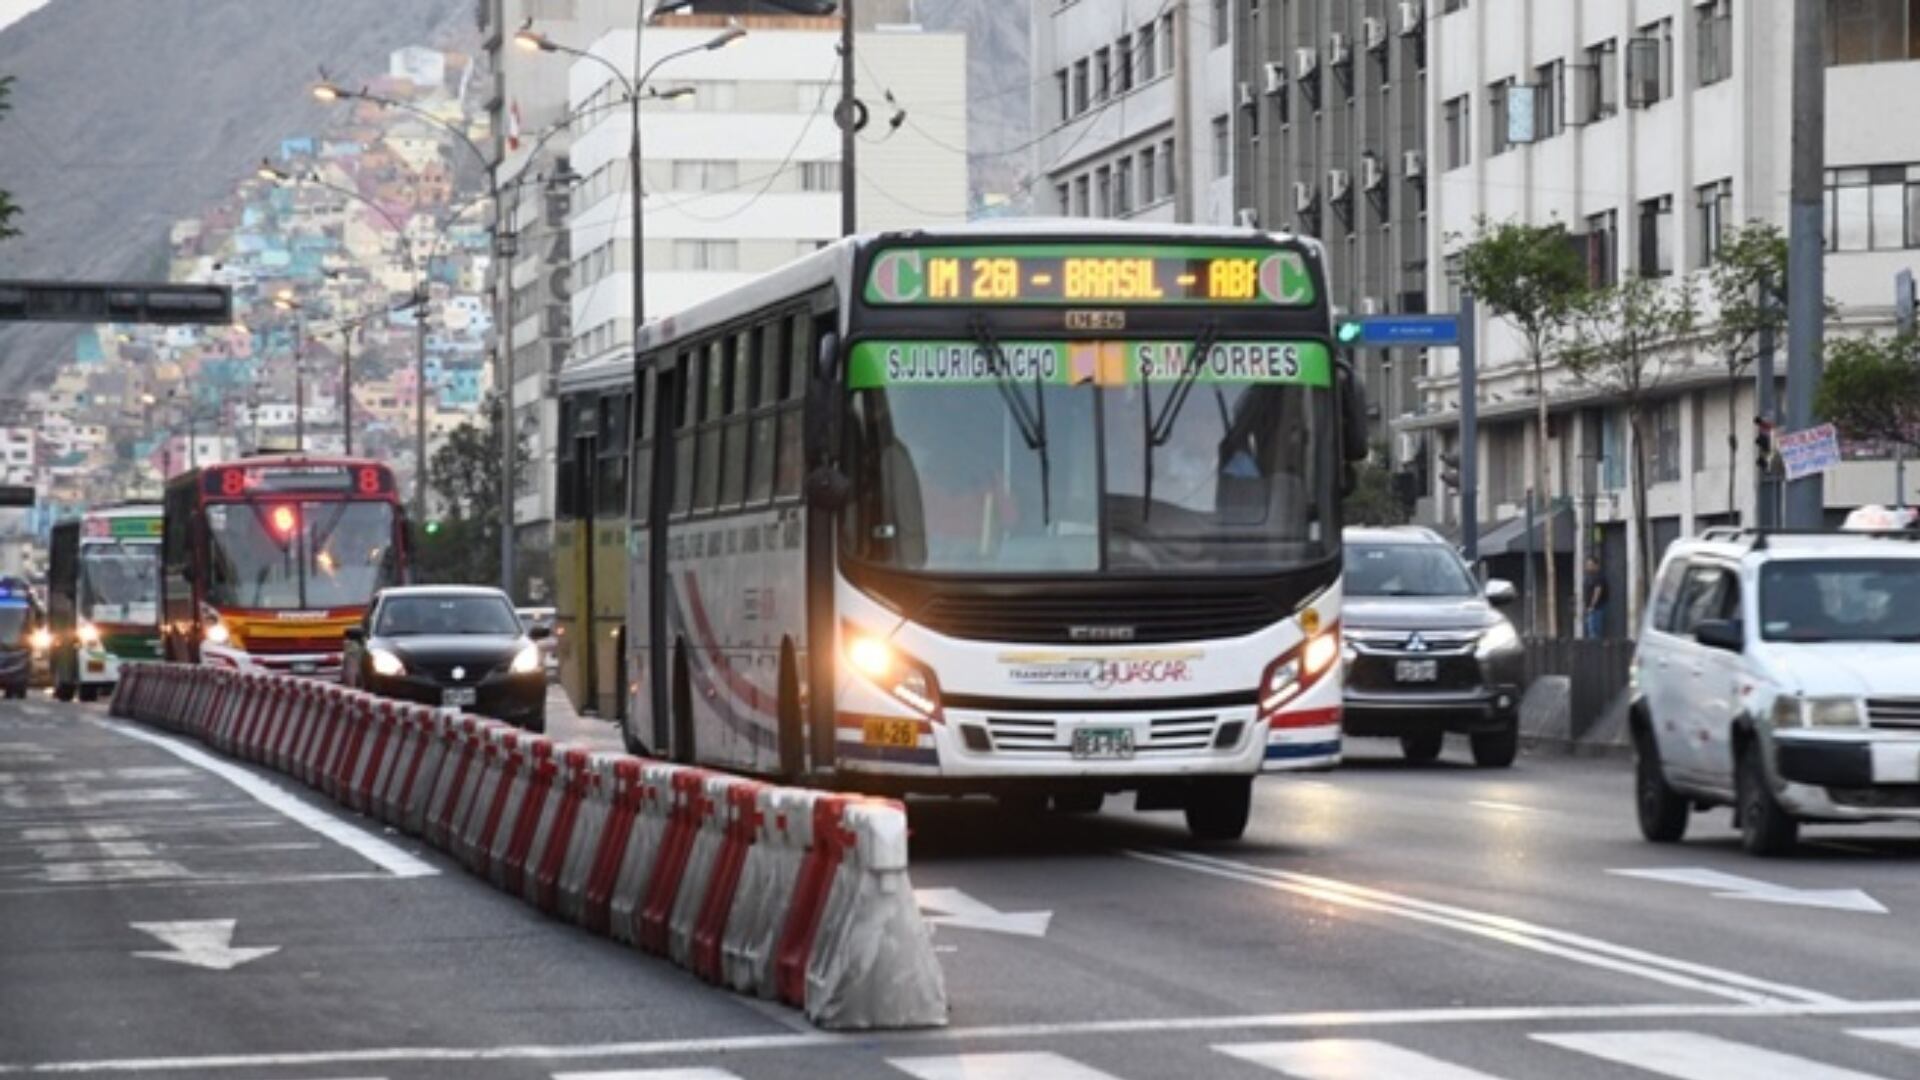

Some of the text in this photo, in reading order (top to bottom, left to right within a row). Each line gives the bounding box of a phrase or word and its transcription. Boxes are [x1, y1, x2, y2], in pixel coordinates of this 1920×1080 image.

[1065, 257, 1164, 298] BRASIL
[222, 468, 243, 495] 8
[359, 467, 379, 494] 8
